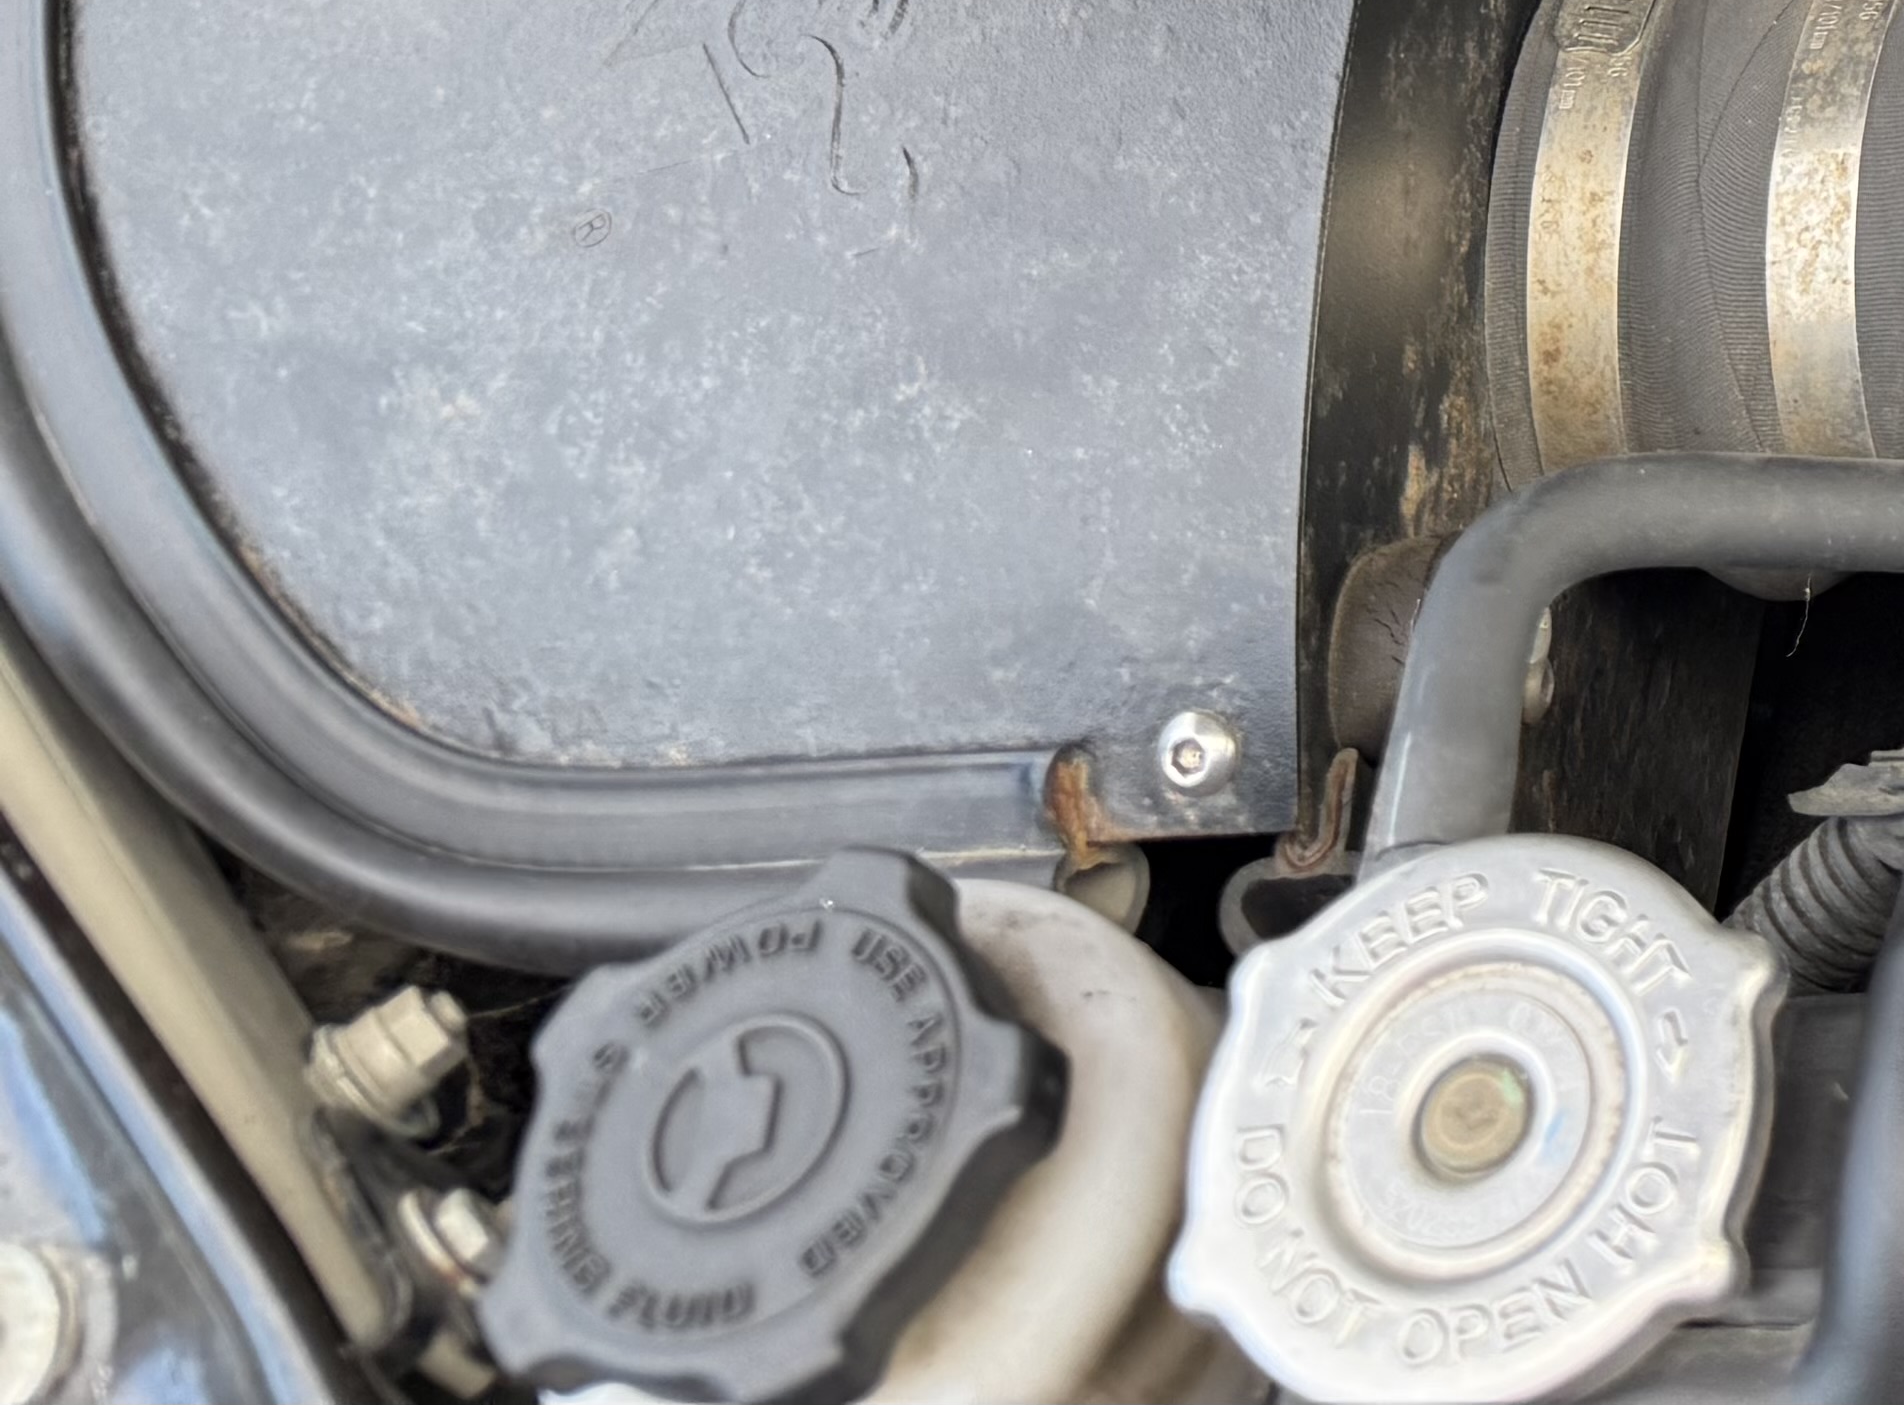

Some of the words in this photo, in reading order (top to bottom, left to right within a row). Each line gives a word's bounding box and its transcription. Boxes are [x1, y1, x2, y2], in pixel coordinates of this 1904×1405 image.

[633, 919, 825, 1028] POWER
[850, 926, 928, 1002] USE
[1308, 869, 1491, 1007] KEEP
[1530, 866, 1693, 997] TIGHT
[797, 1011, 948, 1278] APPROVED
[1233, 1123, 1291, 1227] DO
[1588, 1115, 1701, 1277] HOT
[605, 1278, 758, 1330] FLUID
[1258, 1225, 1388, 1348] NOT
[1396, 1257, 1593, 1367] OPEN
